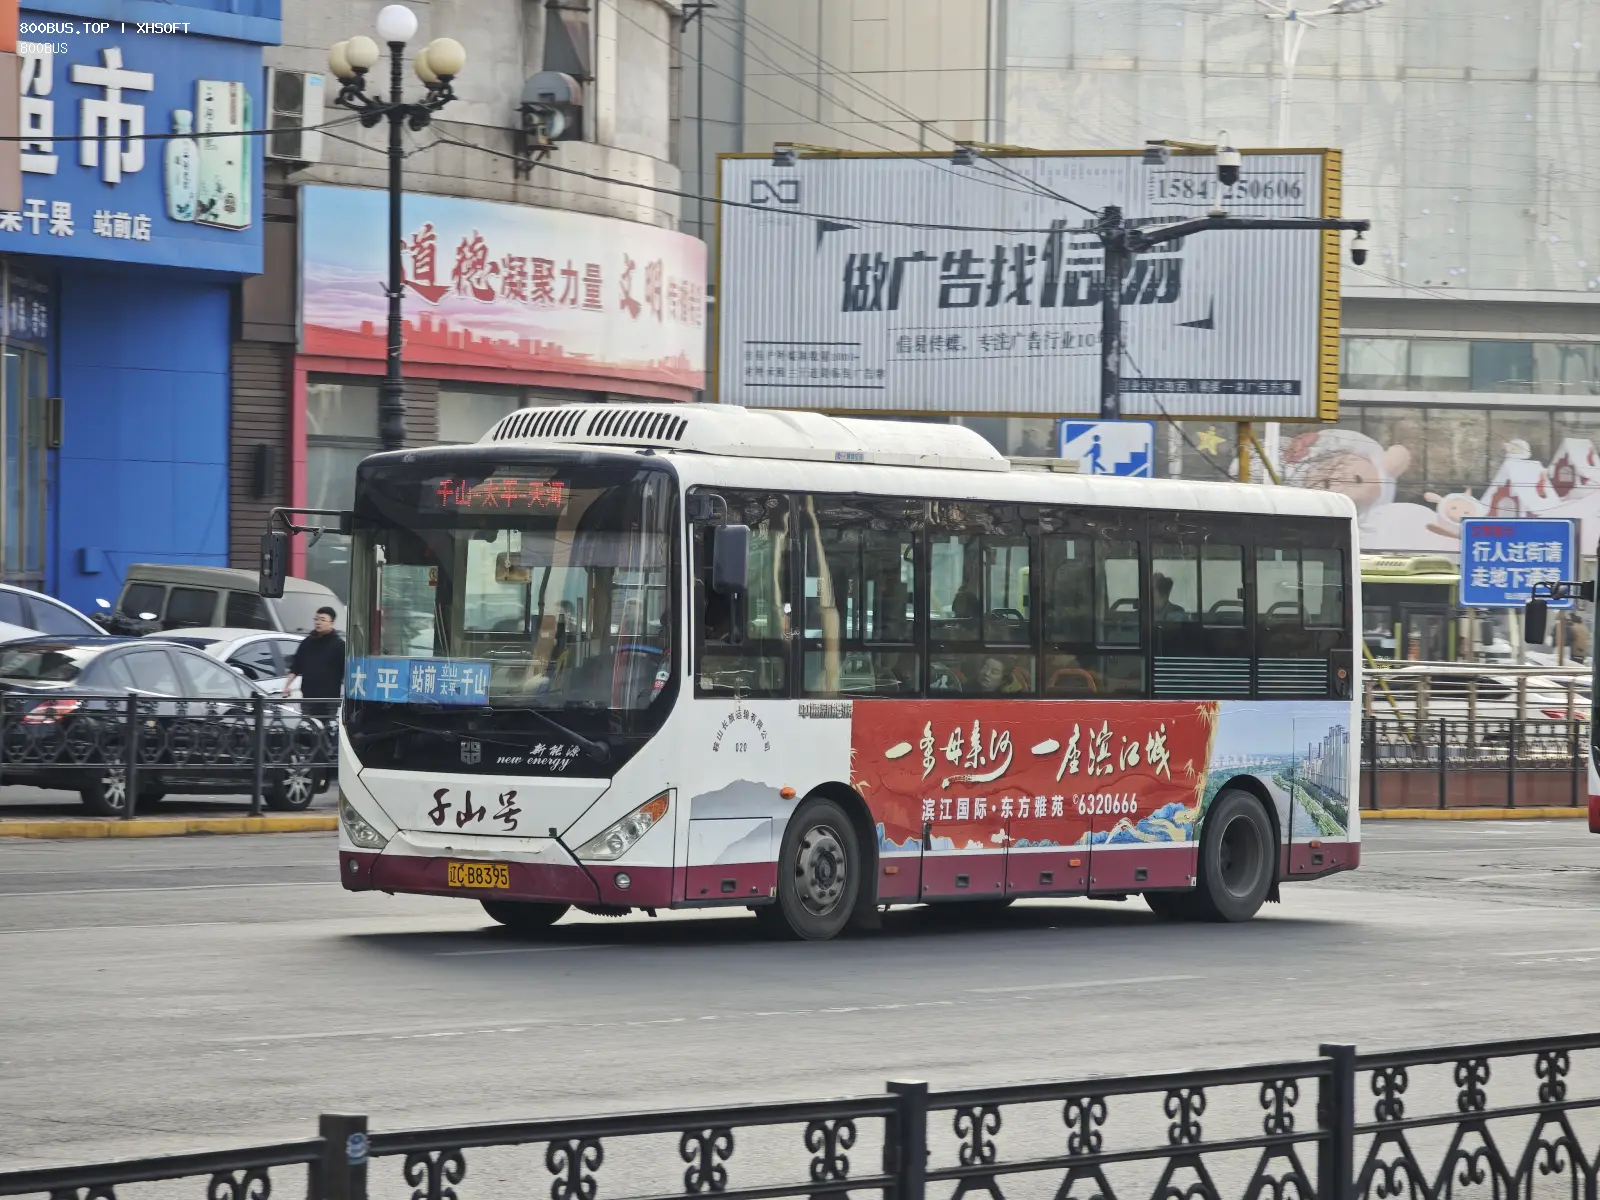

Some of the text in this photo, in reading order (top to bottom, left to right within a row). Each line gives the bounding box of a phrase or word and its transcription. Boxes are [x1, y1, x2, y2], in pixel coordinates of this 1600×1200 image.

[93, 210, 152, 241] 站前店
[1472, 541, 1563, 562] 行人过街请
[349, 665, 399, 699] 太平
[412, 665, 437, 694] 站前
[440, 682, 456, 697] 太平
[461, 668, 487, 696] 千山
[529, 742, 581, 757] 新能源
[496, 756, 572, 771] new energy
[1078, 792, 1138, 815] 6320666
